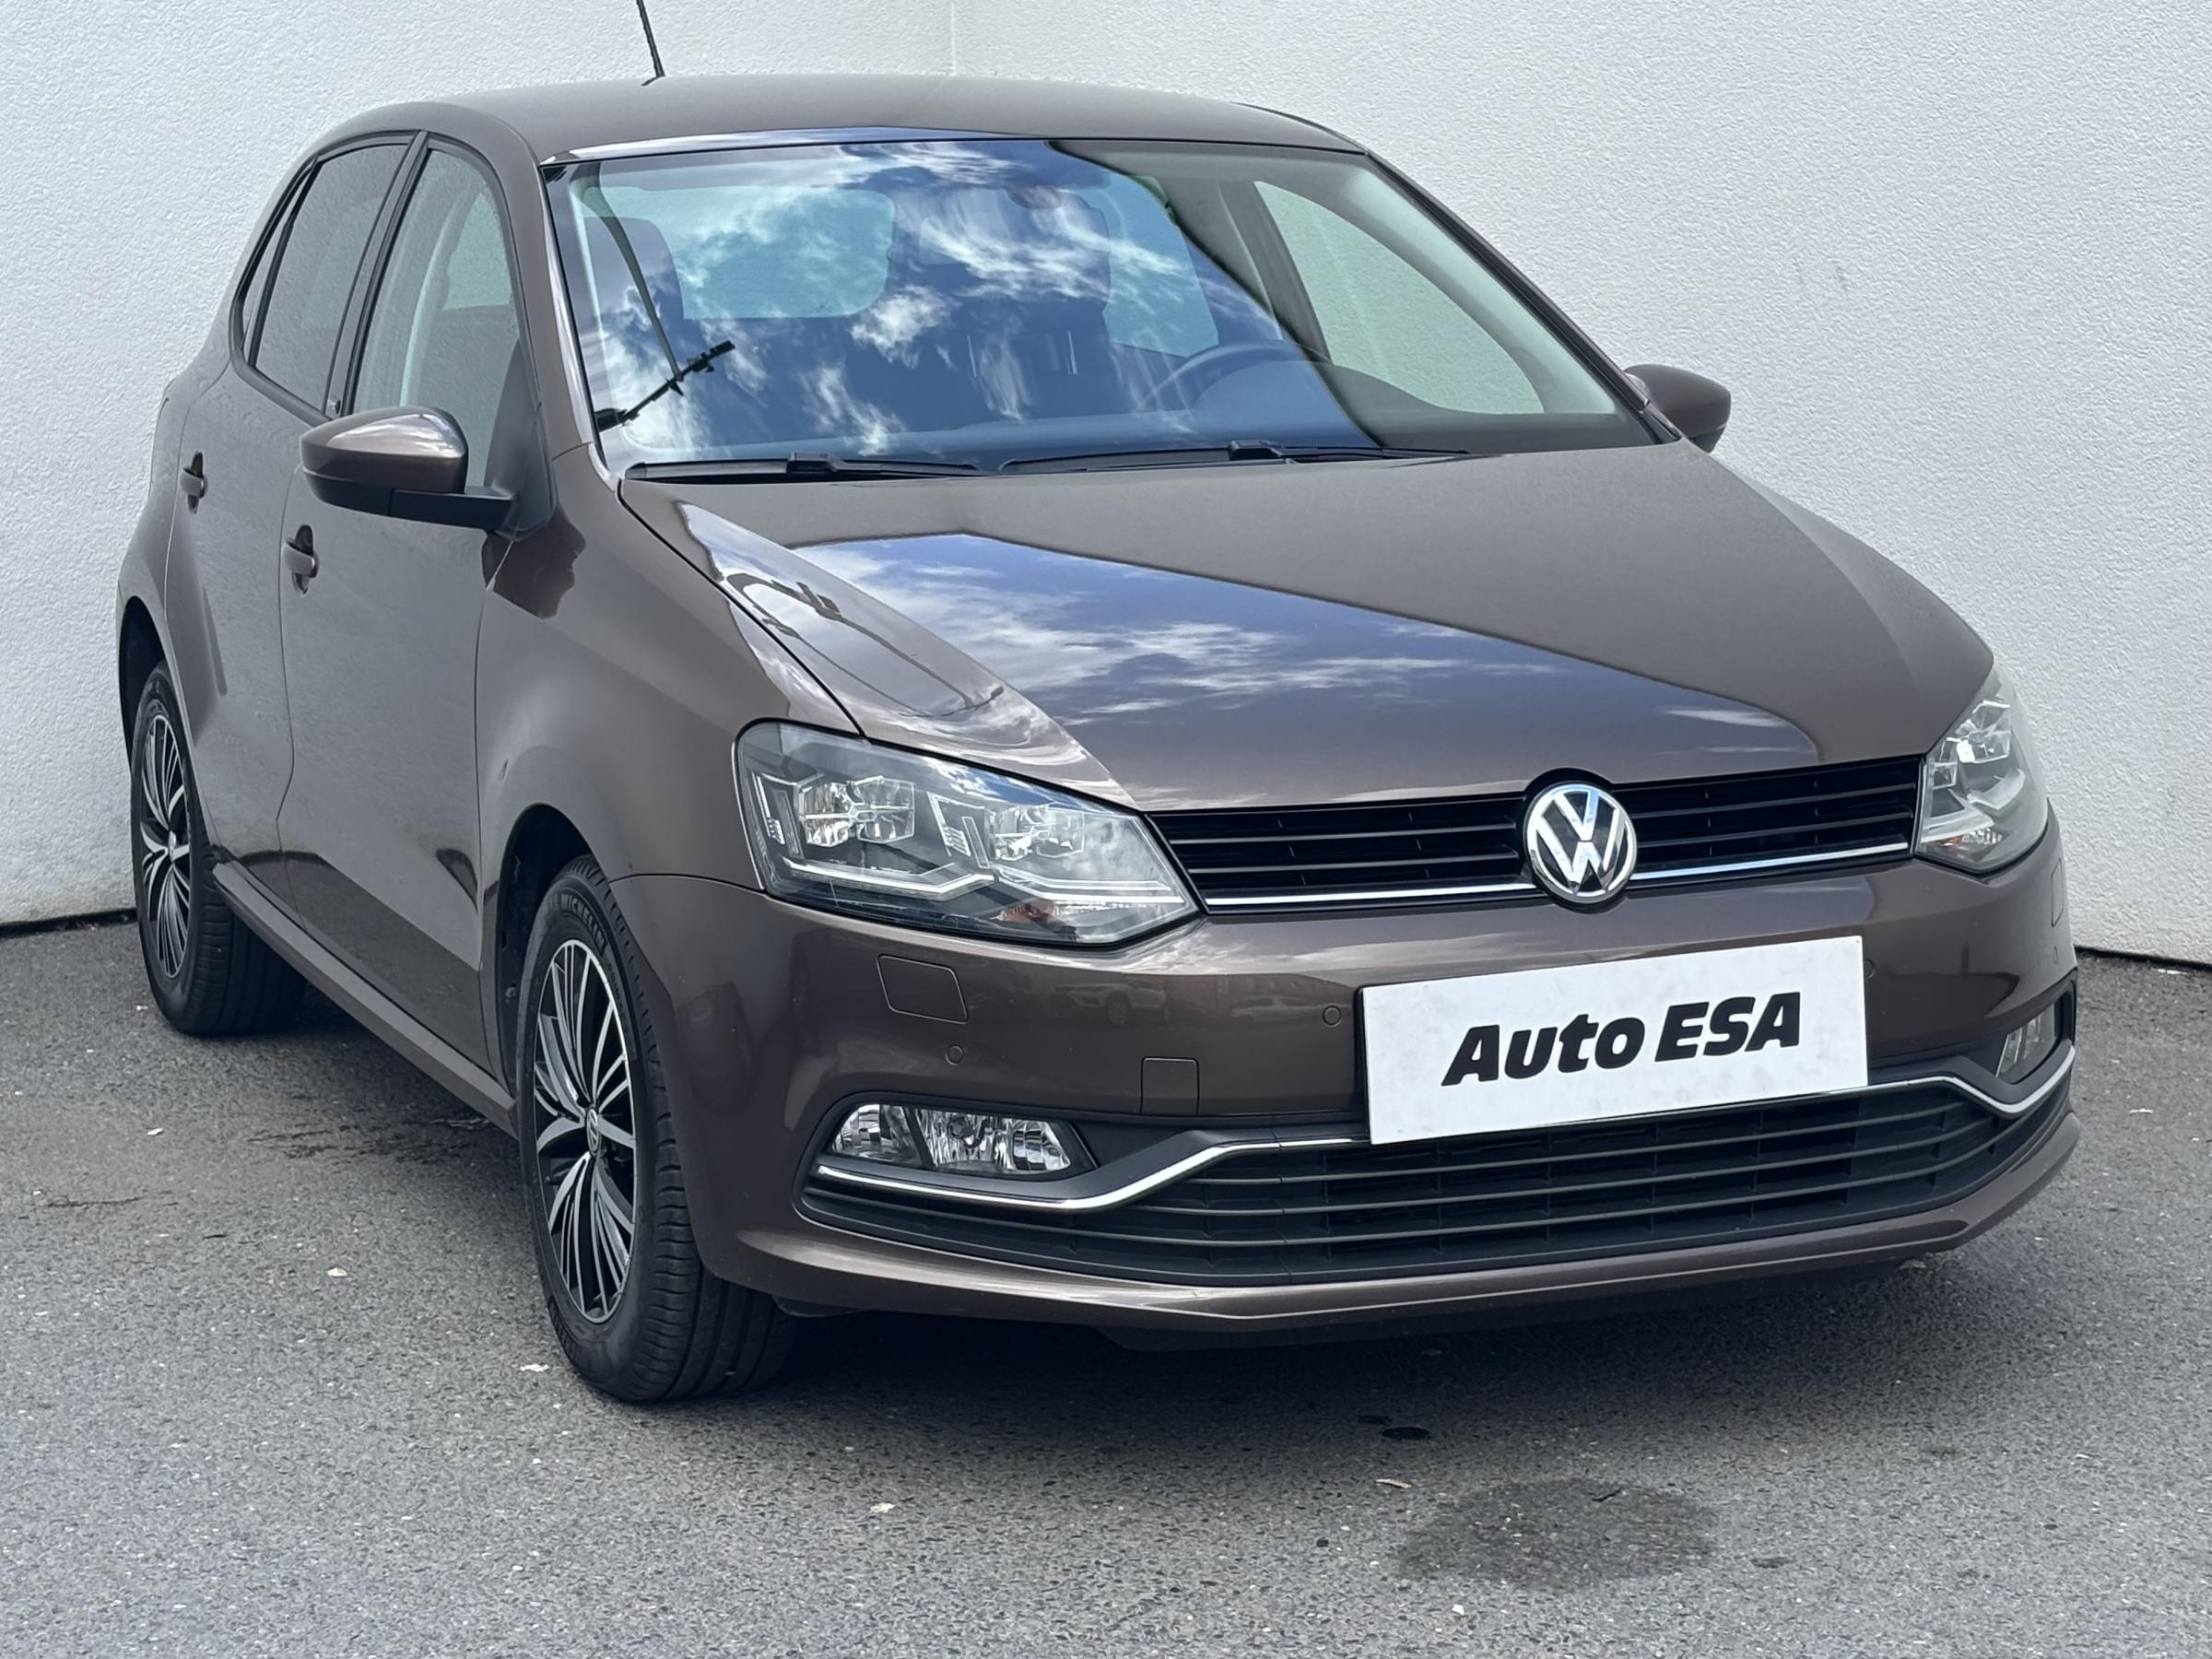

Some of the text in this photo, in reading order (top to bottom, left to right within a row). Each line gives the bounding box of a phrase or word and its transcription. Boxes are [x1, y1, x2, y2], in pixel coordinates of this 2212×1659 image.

[559, 893, 605, 952] MICHELIN
[1441, 993, 1801, 1086] Auto ESA
